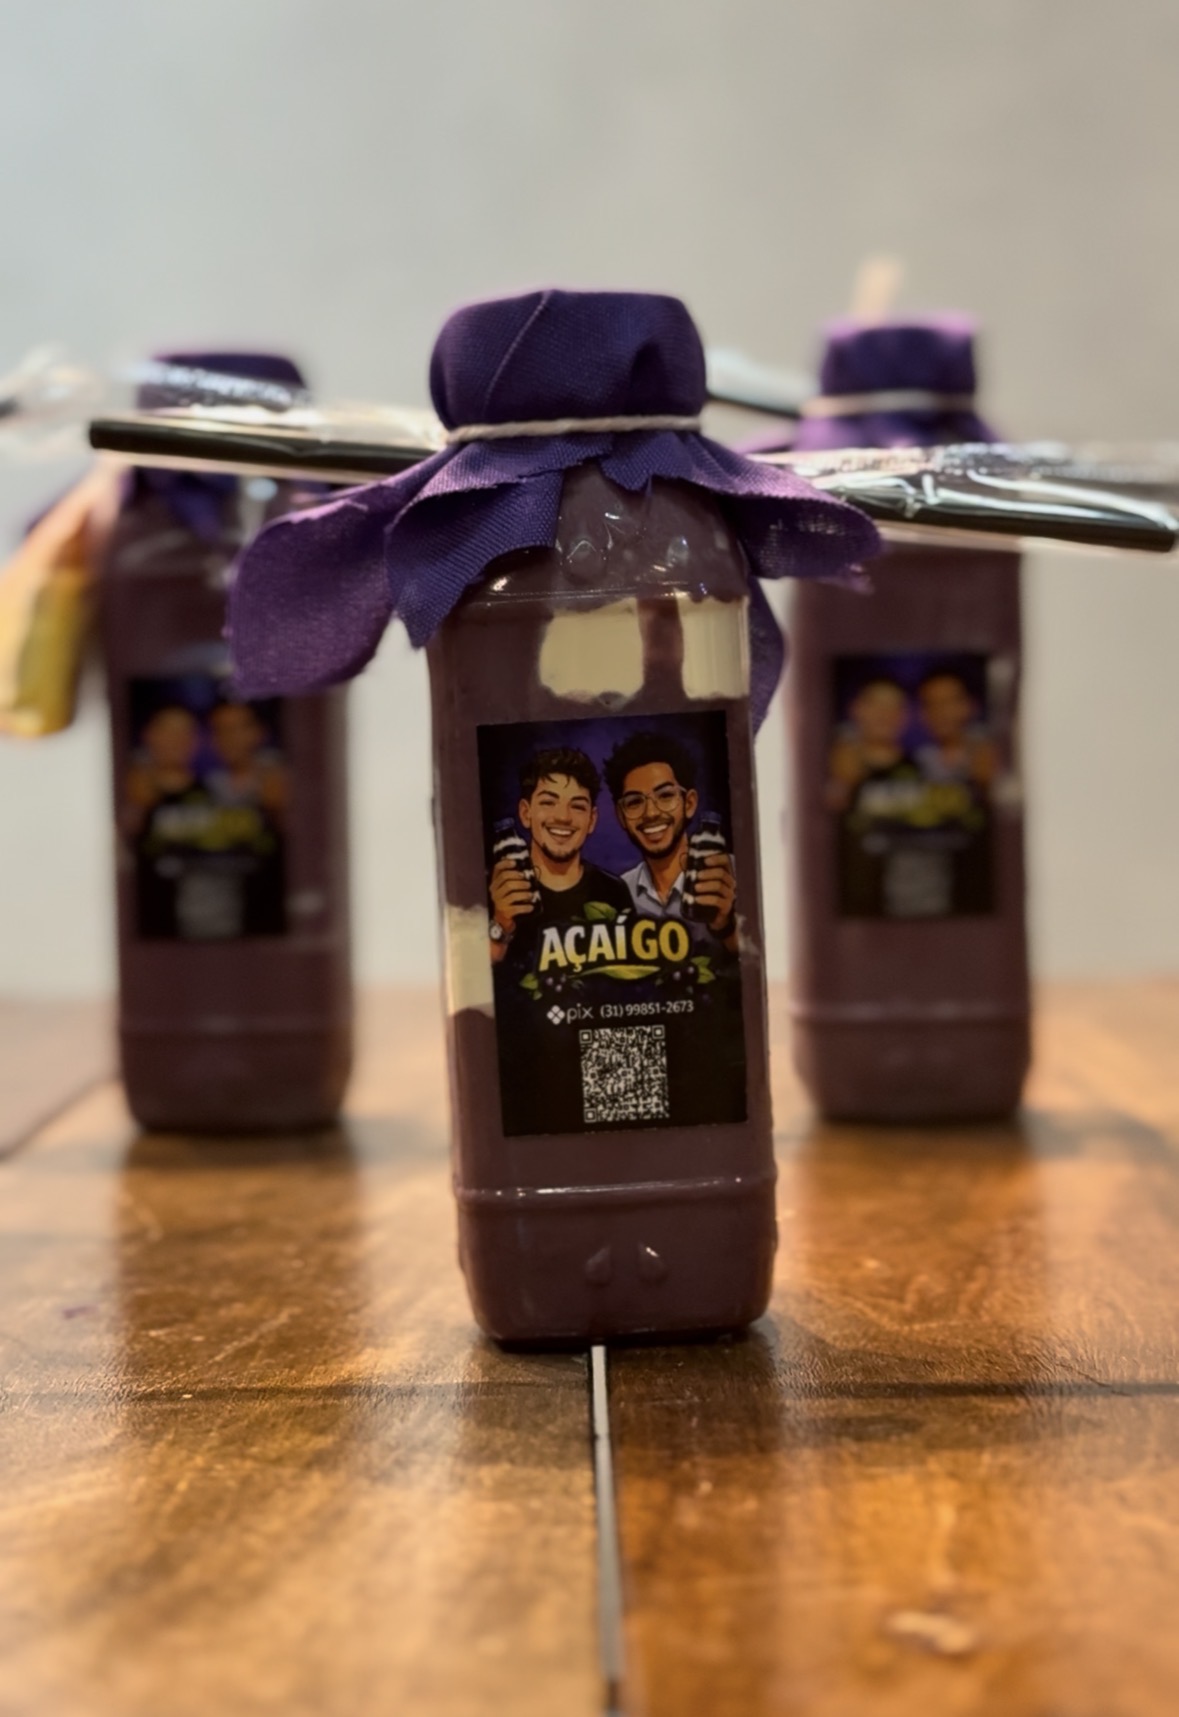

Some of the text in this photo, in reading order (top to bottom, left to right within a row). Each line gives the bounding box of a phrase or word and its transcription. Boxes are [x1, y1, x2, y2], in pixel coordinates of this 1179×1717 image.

[539, 915, 689, 973] AÇAÍ GO
[566, 1000, 694, 1024] pix (31) 99851-2673
